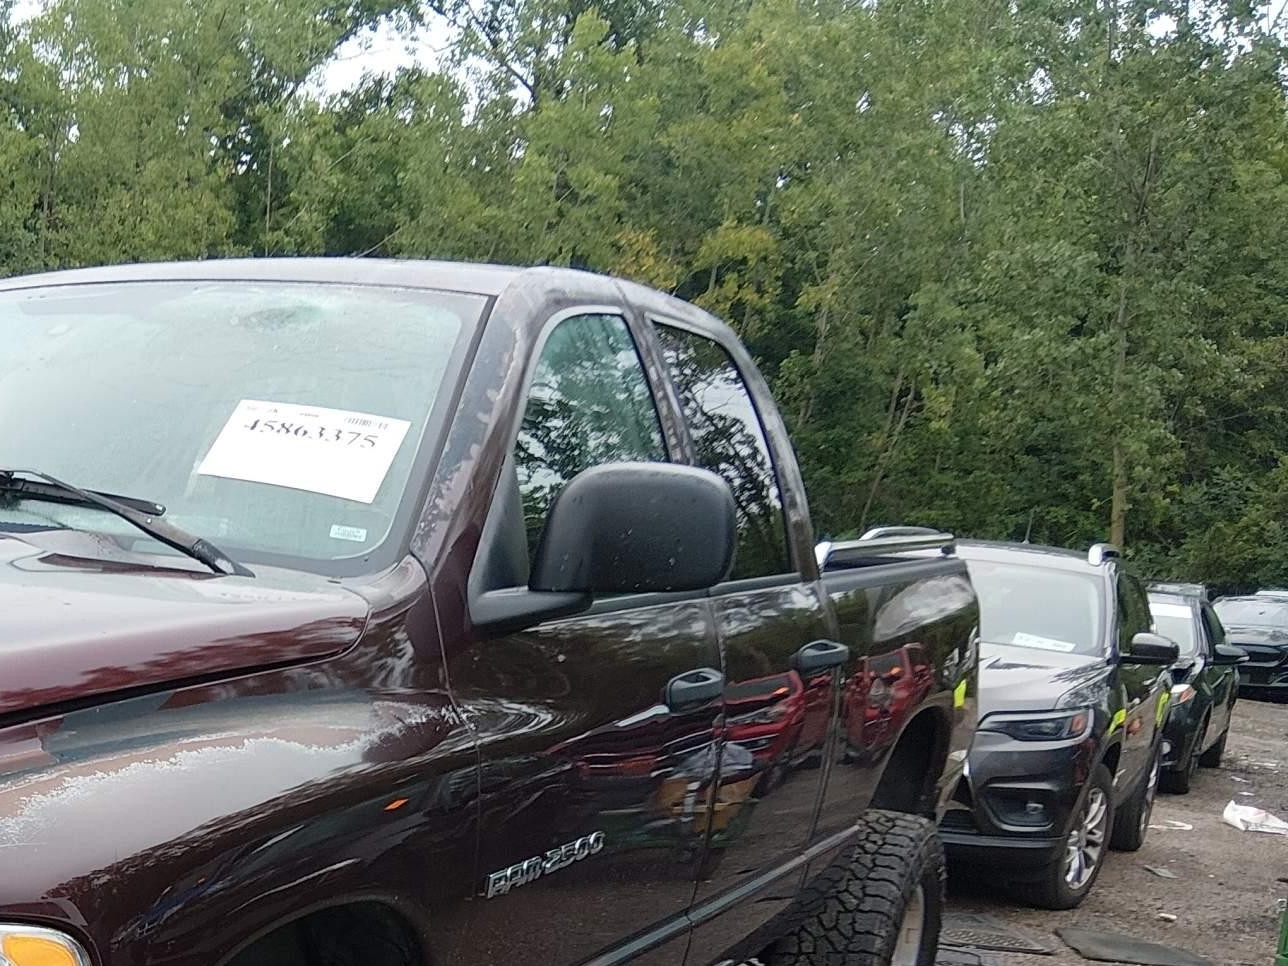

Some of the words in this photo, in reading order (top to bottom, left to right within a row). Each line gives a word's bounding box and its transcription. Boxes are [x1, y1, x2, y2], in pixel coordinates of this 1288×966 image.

[242, 418, 380, 449] 45863375
[487, 855, 543, 899] RAM
[543, 830, 606, 874] 2500
